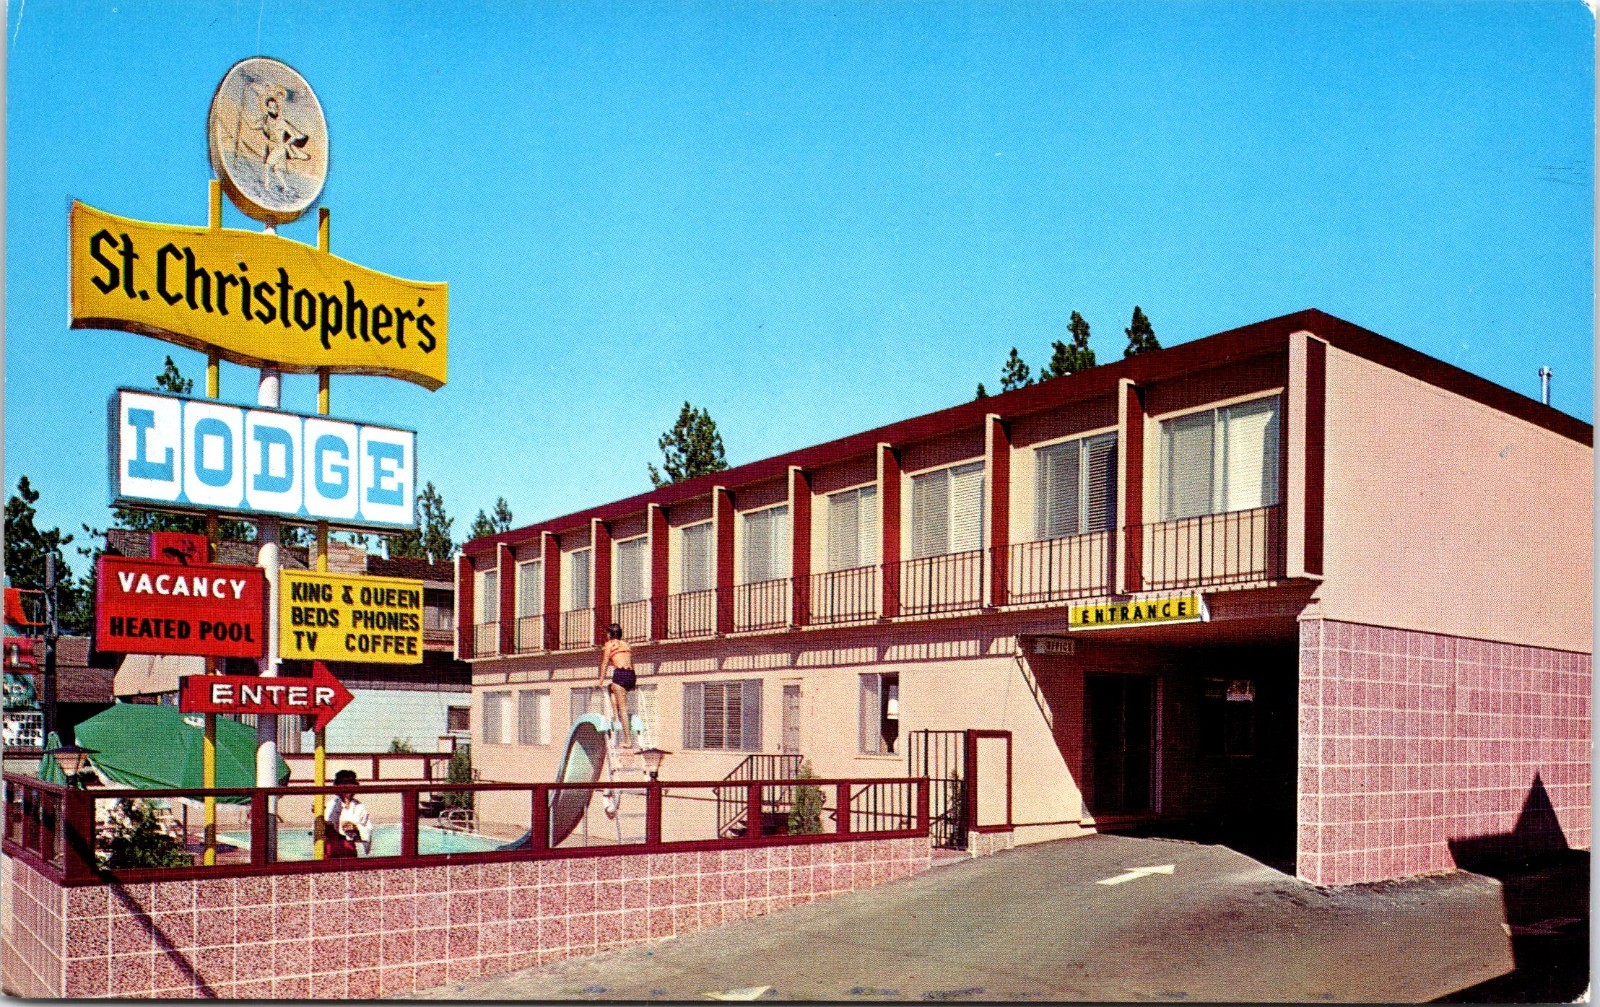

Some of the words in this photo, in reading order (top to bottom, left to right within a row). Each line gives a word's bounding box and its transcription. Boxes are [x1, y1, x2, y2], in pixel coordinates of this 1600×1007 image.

[90, 228, 151, 301] St.
[156, 242, 437, 354] Christopher's
[127, 407, 405, 507] LODGE
[117, 571, 247, 600] VACANCY
[291, 582, 332, 604] KING
[341, 585, 354, 606] &
[359, 587, 420, 610] QUEEN
[291, 606, 339, 628] BEDS
[352, 609, 420, 632] PHONES
[1081, 601, 1187, 624] ENTRANCE
[109, 615, 191, 640] HEATED
[200, 621, 255, 643] POOL
[294, 630, 318, 652] TV
[344, 633, 418, 656] COFFEE
[211, 683, 336, 706] ENTER
